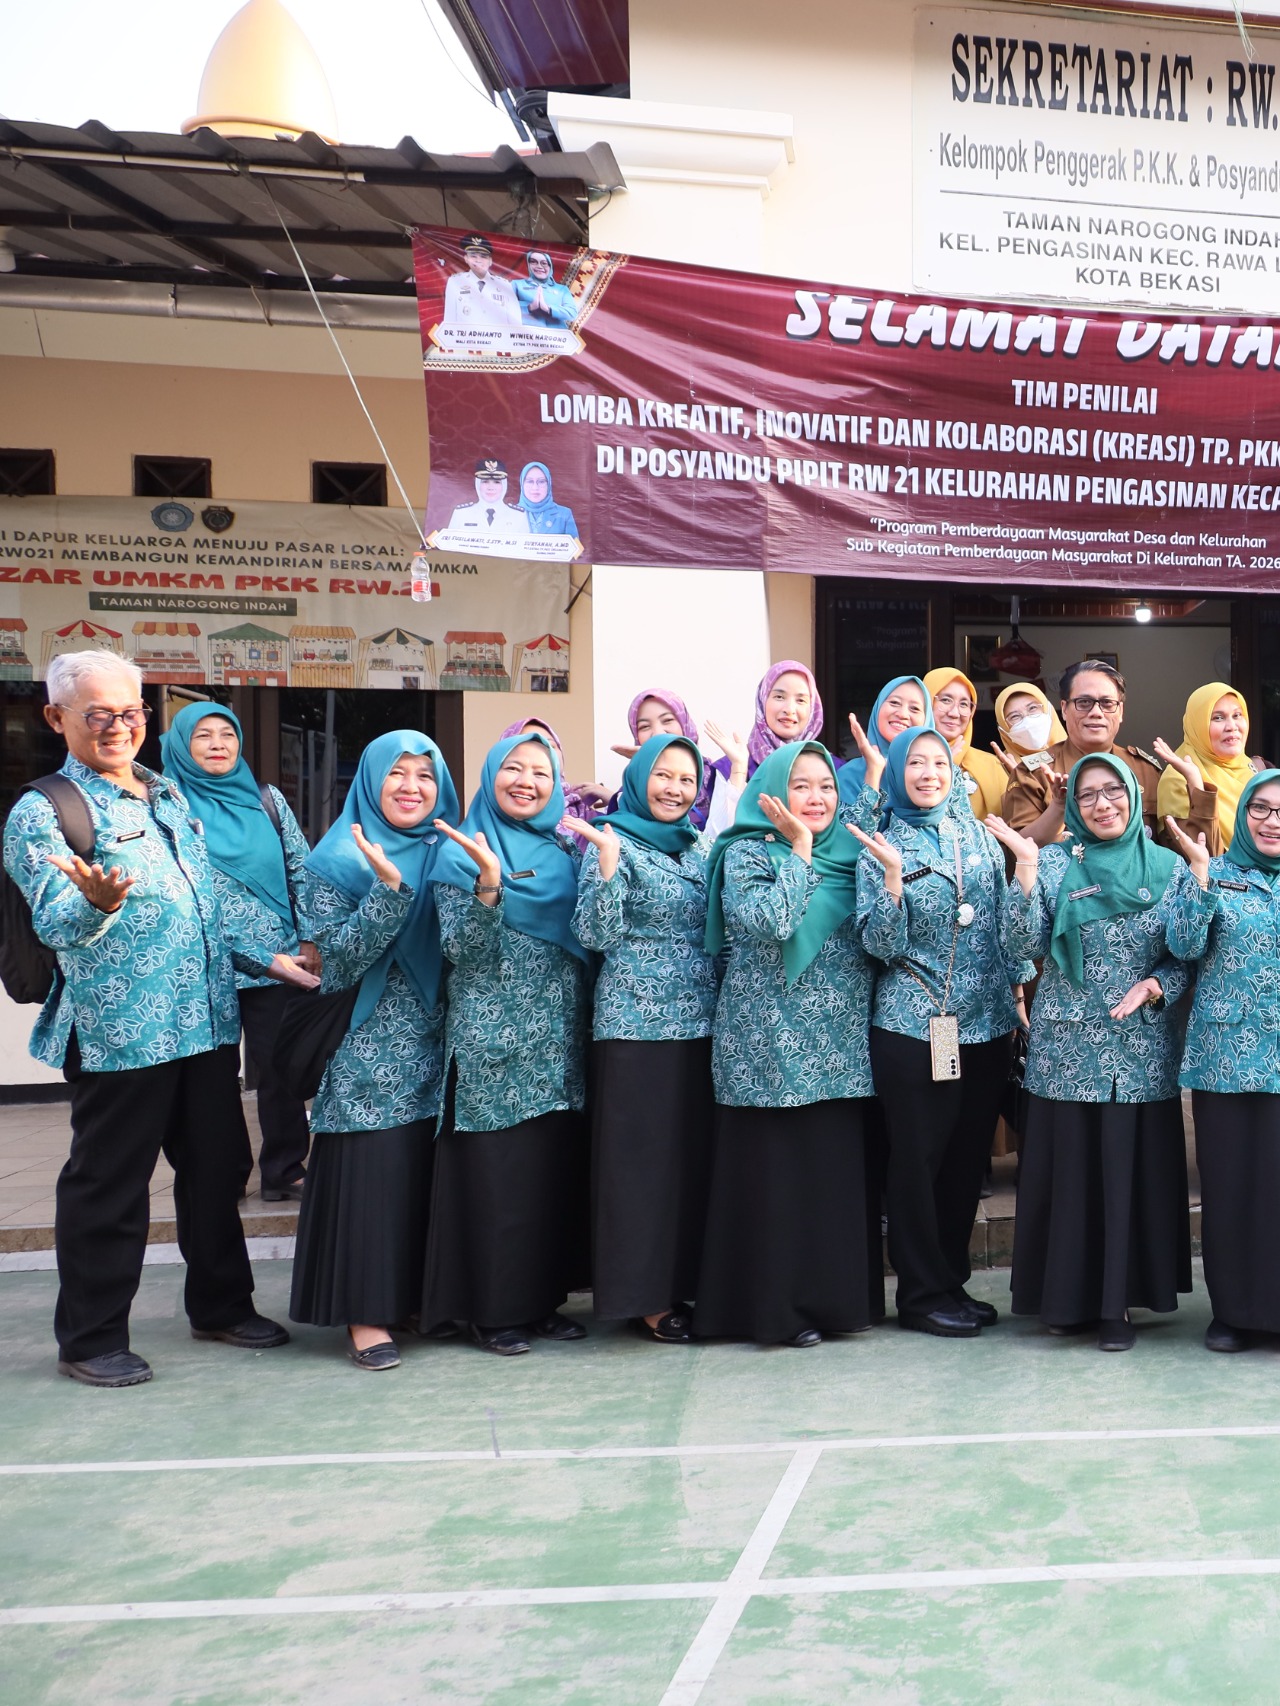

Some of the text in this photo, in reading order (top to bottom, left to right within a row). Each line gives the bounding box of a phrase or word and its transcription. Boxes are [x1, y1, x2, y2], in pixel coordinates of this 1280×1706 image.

[951, 33, 1194, 122] SEKRETARIAT
[1226, 61, 1279, 131] RW.
[939, 132, 1028, 179] Kelompok
[1034, 139, 1127, 187] Penggerak
[1133, 149, 1183, 186] P.K.K.
[1189, 154, 1200, 187] &
[1003, 211, 1080, 233] TAMAN
[1088, 217, 1217, 244] NAROGONG
[939, 231, 990, 252] KEL.
[998, 236, 1143, 263] PENGASINAN
[1150, 247, 1200, 268] KEC.
[1206, 251, 1267, 273] RAWA
[1076, 267, 1220, 293] KOTA BEKASI
[785, 290, 1098, 356] SELAMAT
[1012, 379, 1158, 415] TIM PENILAI
[540, 393, 634, 426] LOMBA
[637, 398, 750, 440] KREATIF,
[756, 409, 872, 444] INOVATIF
[877, 417, 930, 447] DAN
[935, 421, 1087, 457] KOLABORASI
[1092, 429, 1195, 467] (KREASI)
[1200, 437, 1234, 465] TP.
[597, 444, 625, 474] DI
[631, 447, 771, 483] POSYANDU
[777, 457, 843, 488] PIPIT
[848, 463, 890, 492] RW
[894, 465, 919, 494] 21
[925, 467, 1070, 502] KELURAHAN
[1075, 475, 1227, 509] PENGASINAN
[14, 531, 78, 543] DAPUR
[86, 533, 187, 548] KELUARGA
[194, 538, 268, 551] MENUJU
[275, 542, 335, 554] PASAR
[341, 544, 405, 556] LOKAL:
[941, 521, 1044, 541] Pemberdayaan
[1049, 527, 1130, 545] Masyarakat
[1133, 530, 1166, 545] Desa
[1170, 531, 1195, 546] dan
[1199, 533, 1267, 549] Kelurahan
[61, 549, 189, 564] MEMBANGUN
[195, 554, 323, 569] KEMANDIRIAN
[847, 538, 873, 552] Sub
[878, 540, 940, 557] Kegiatan
[944, 543, 1047, 563] Pemberdayaan
[1052, 549, 1132, 566] Masyarakat
[1136, 552, 1151, 564] Di
[1154, 552, 1222, 567] Kelurahan
[1226, 554, 1246, 568] TA.
[93, 570, 225, 590] UMKM
[235, 574, 319, 592] PKK
[100, 597, 288, 611] TAMAN NAROGONG INDAH
